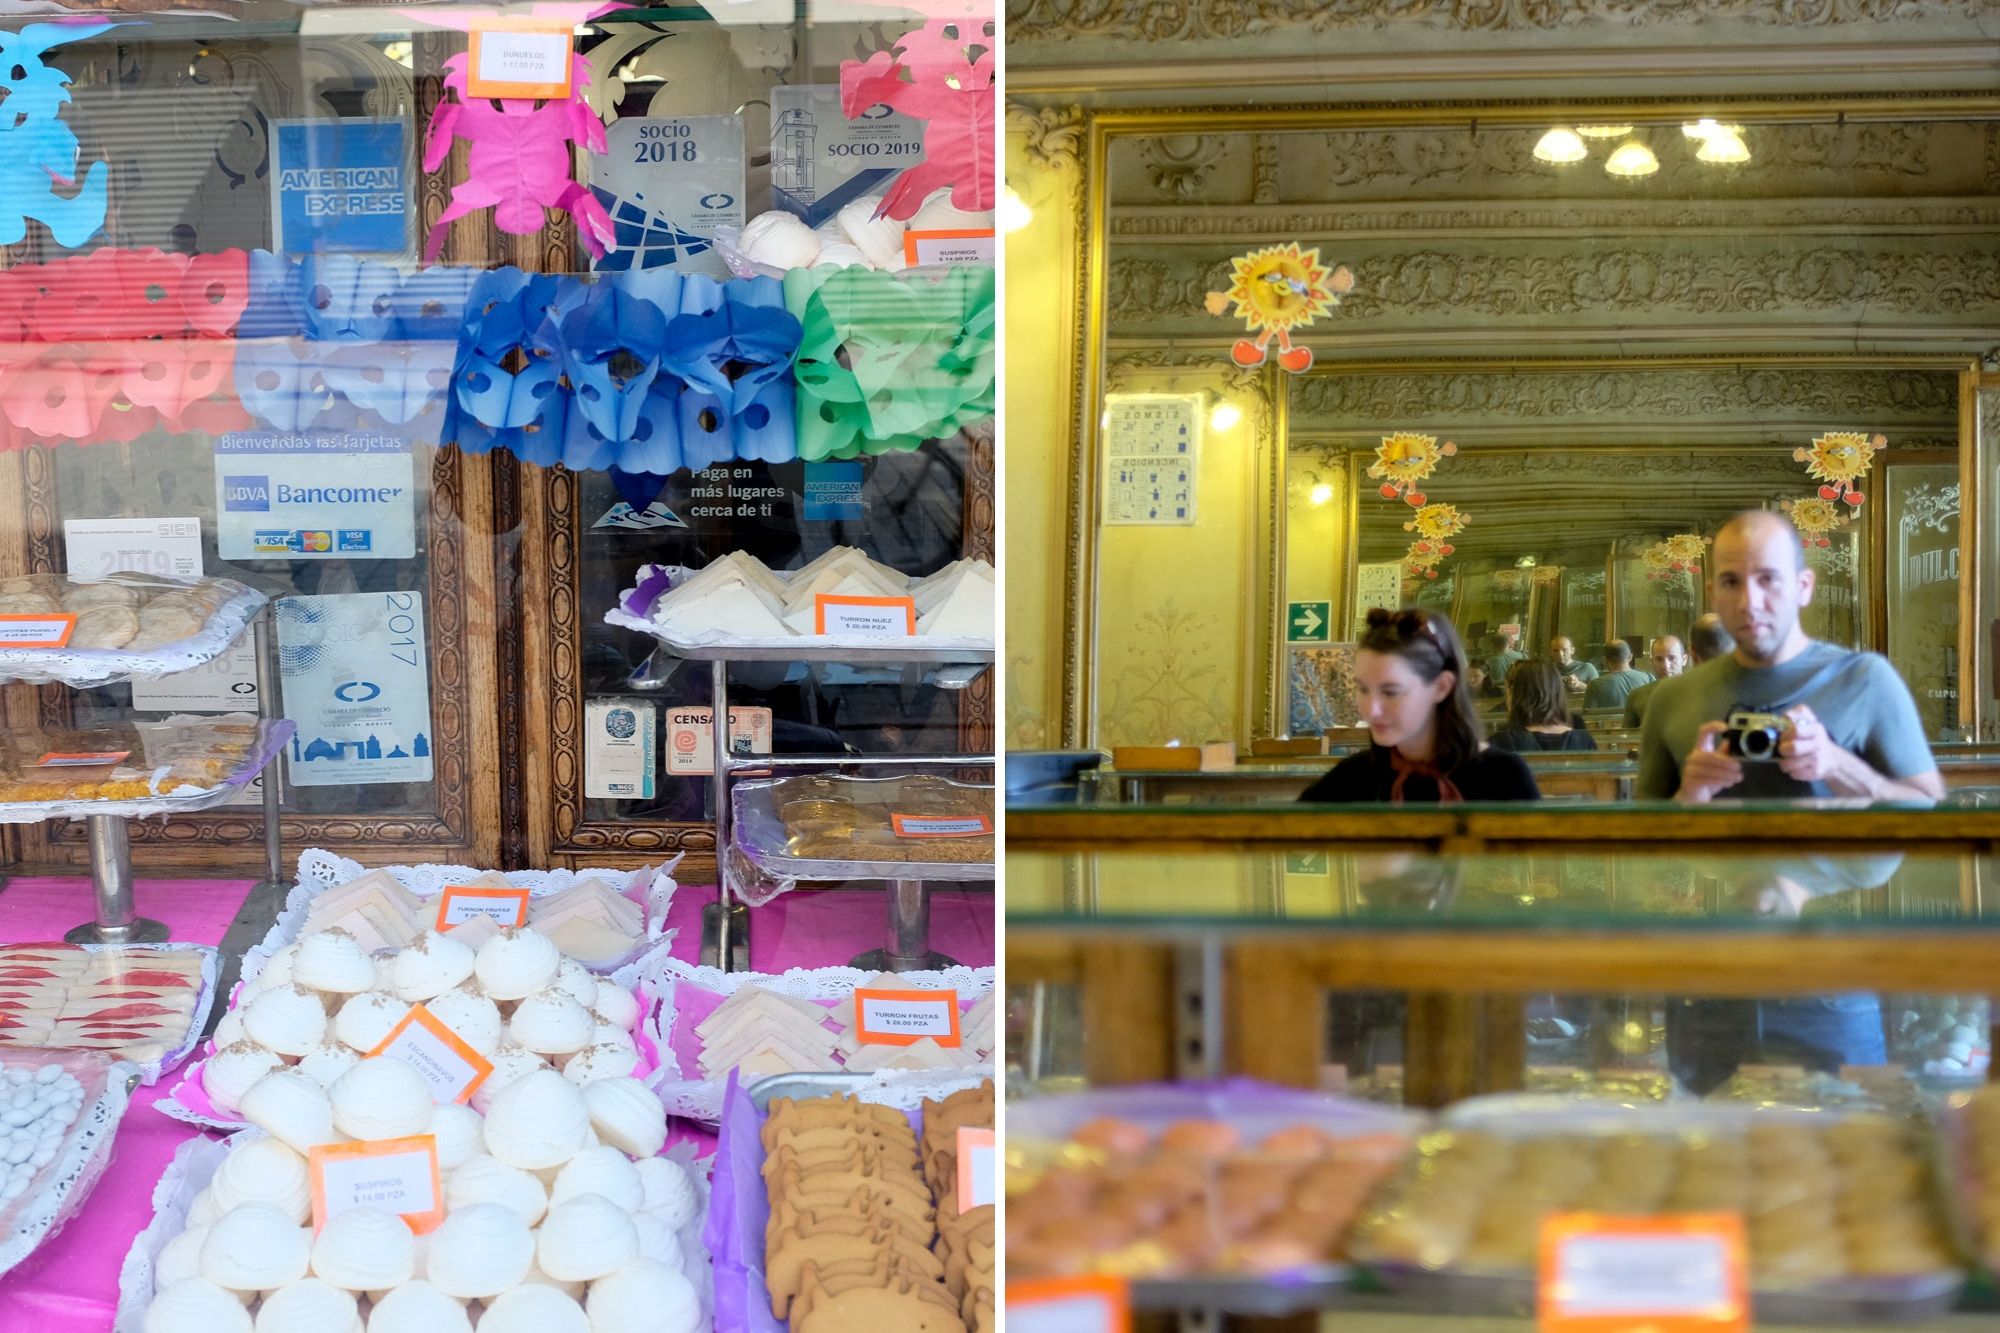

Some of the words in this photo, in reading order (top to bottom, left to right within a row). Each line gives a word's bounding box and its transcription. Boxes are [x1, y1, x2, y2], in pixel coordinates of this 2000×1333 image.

[634, 140, 697, 163] 2018
[828, 143, 880, 157] SOCIO
[884, 142, 921, 155] 2019
[280, 167, 398, 191] AMERICAN
[305, 193, 404, 215] EXPRESS
[733, 468, 752, 479] en
[226, 486, 268, 501] BBVA
[277, 483, 402, 503] Bancomer
[691, 484, 724, 498] más
[728, 484, 785, 500] lugares
[805, 481, 861, 493] AMERICAN
[815, 493, 864, 504] EXPRESS
[691, 506, 734, 517] cerca
[737, 503, 757, 517] de
[760, 503, 772, 517] ti
[386, 593, 418, 667] 2017
[1928, 689, 1960, 698] EMPU
[674, 715, 737, 724] CENSAO
